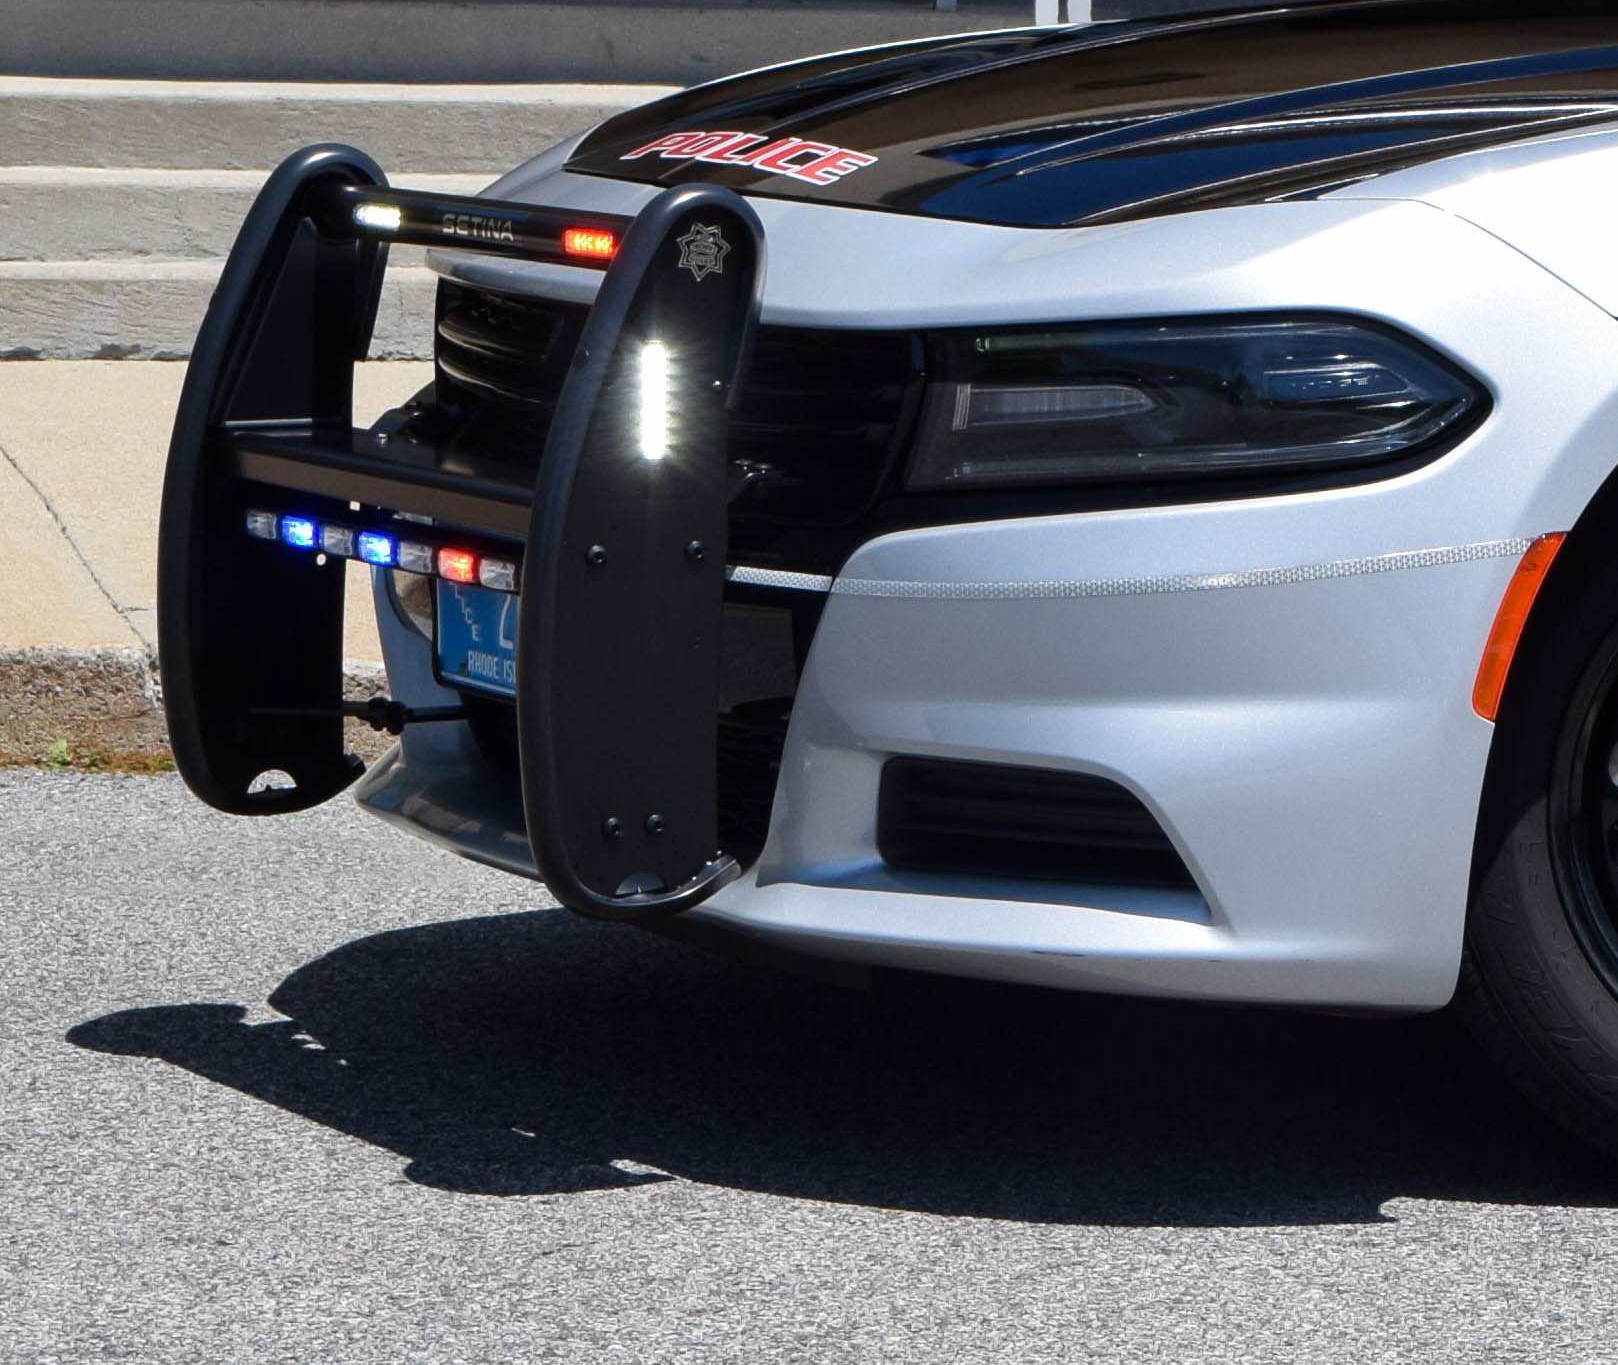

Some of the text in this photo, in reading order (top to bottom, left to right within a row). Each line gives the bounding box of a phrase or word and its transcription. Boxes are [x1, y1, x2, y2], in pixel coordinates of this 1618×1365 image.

[619, 130, 879, 186] POLICE
[442, 213, 514, 241] SETINA
[467, 649, 499, 680] RHODE
